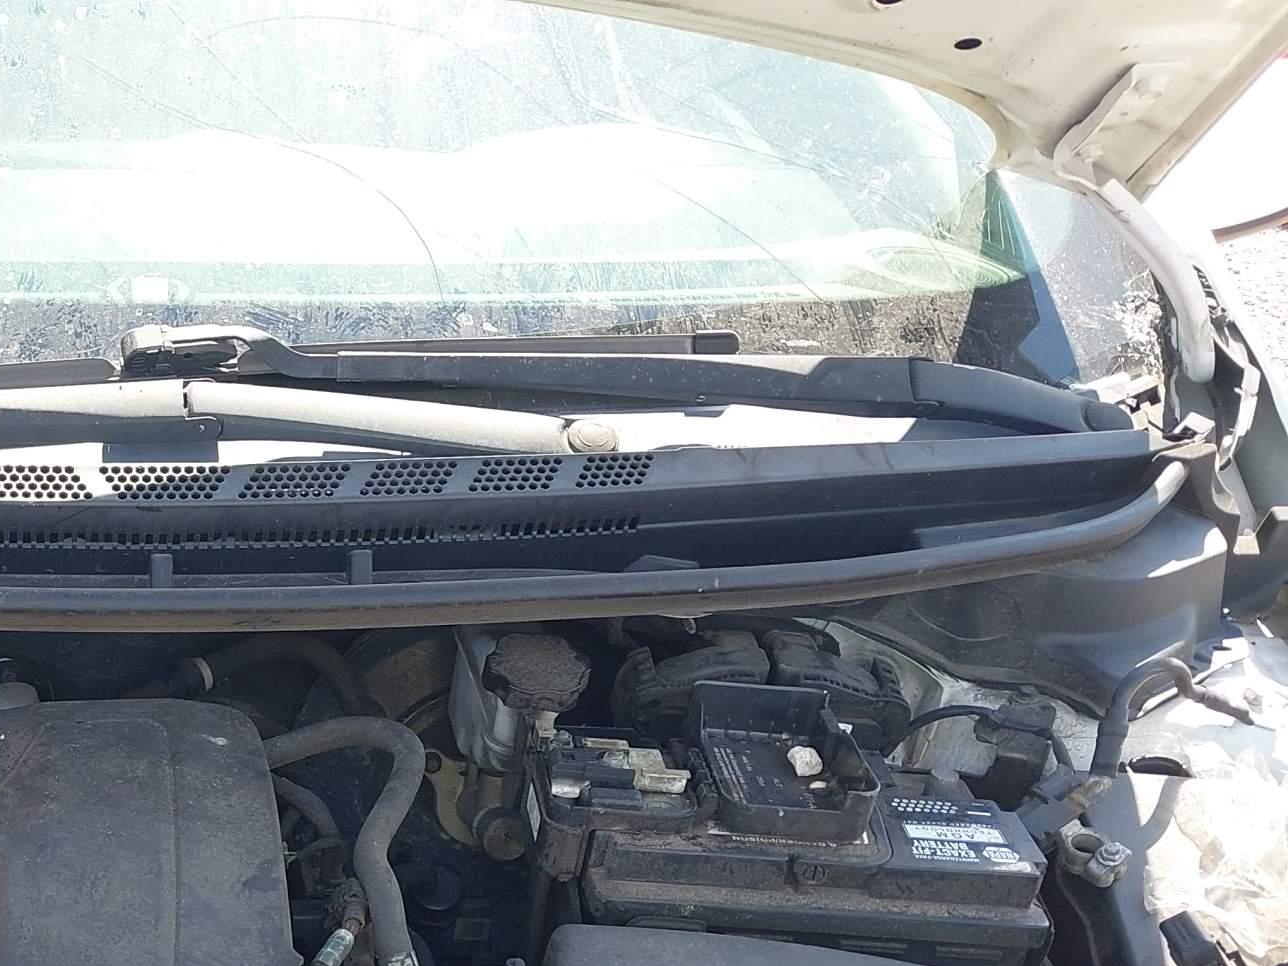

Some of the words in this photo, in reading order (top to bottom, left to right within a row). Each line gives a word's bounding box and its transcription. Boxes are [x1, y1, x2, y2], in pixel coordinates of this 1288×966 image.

[935, 831, 975, 841] AGM
[912, 839, 969, 850] BATTERY
[912, 847, 976, 858] EXACT-FIT
[985, 848, 1018, 861] NAPA
